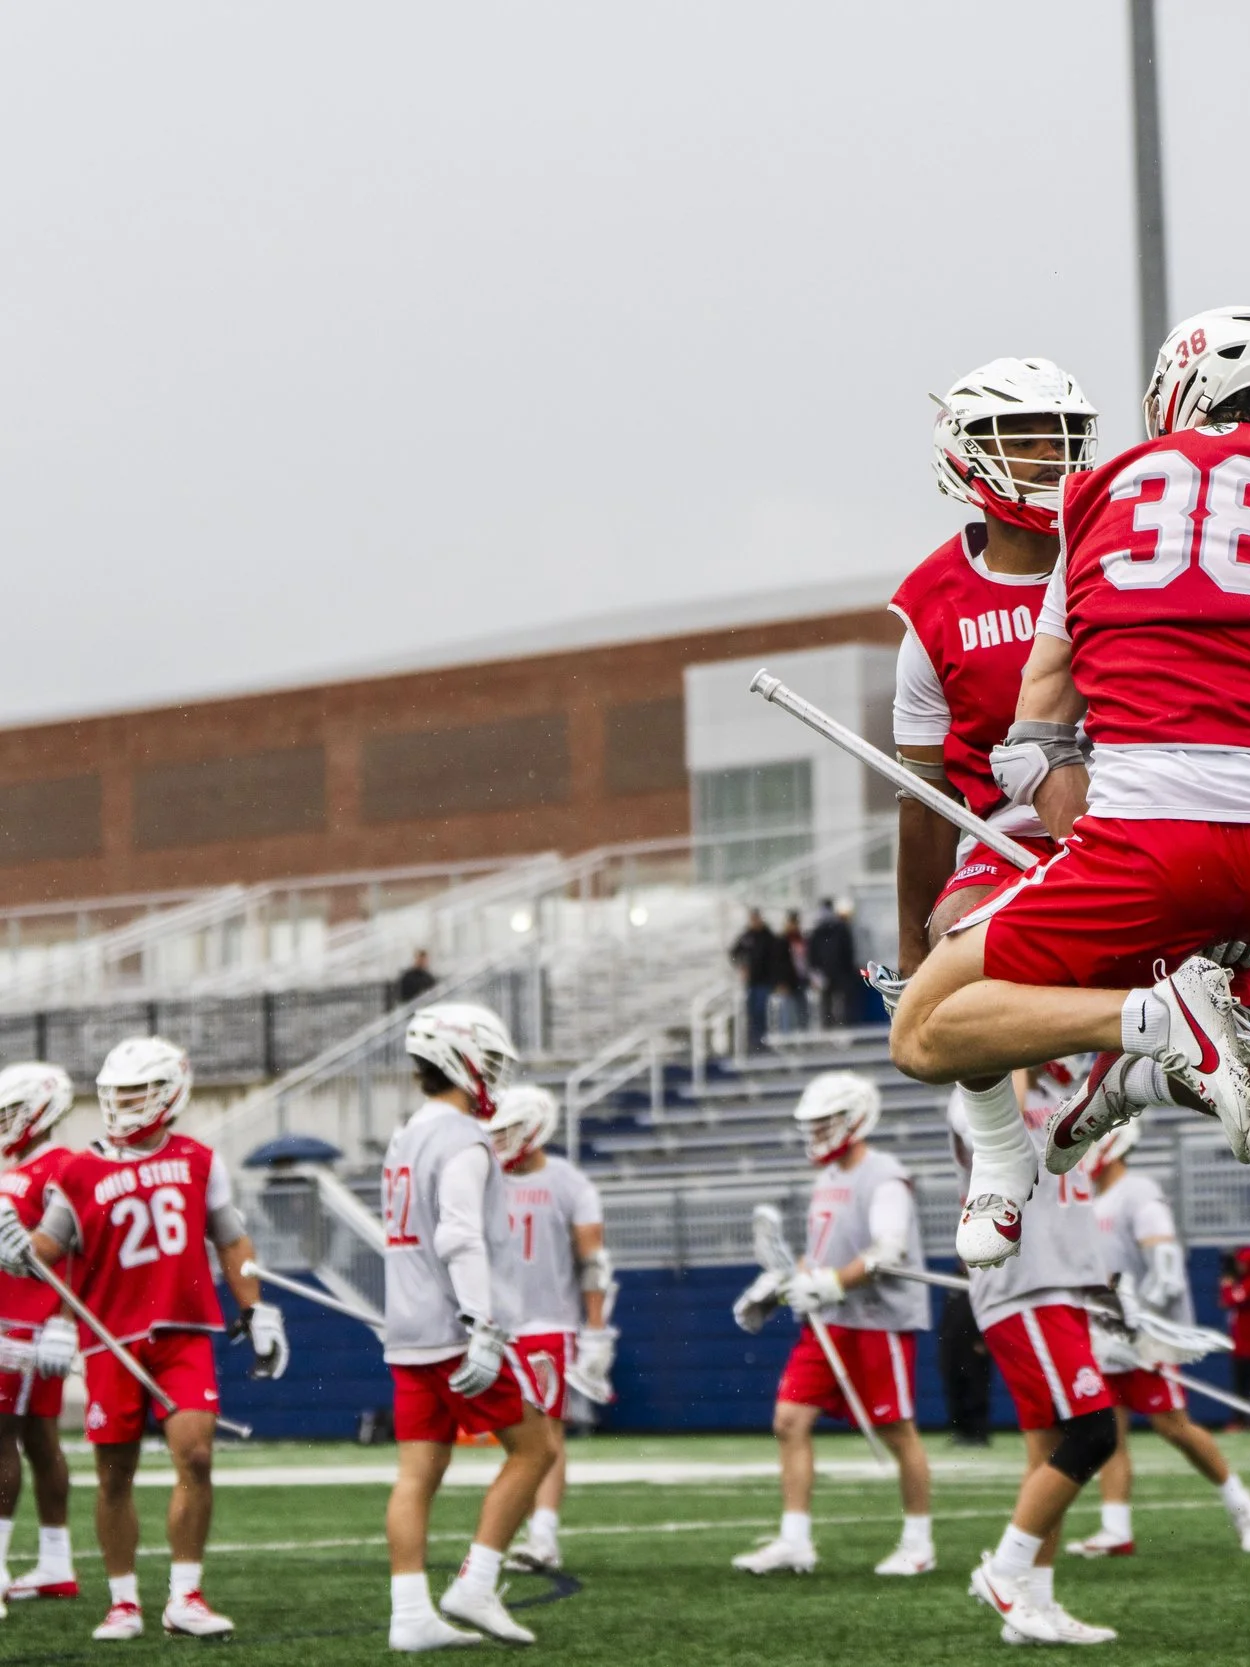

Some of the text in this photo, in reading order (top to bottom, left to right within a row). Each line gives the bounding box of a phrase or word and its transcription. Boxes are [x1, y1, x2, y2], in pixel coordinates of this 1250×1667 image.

[1175, 328, 1207, 368] 38
[964, 439, 982, 455] STX
[958, 604, 1034, 652] OHIO
[138, 1158, 193, 1188] STATE
[110, 1186, 188, 1269] 26
